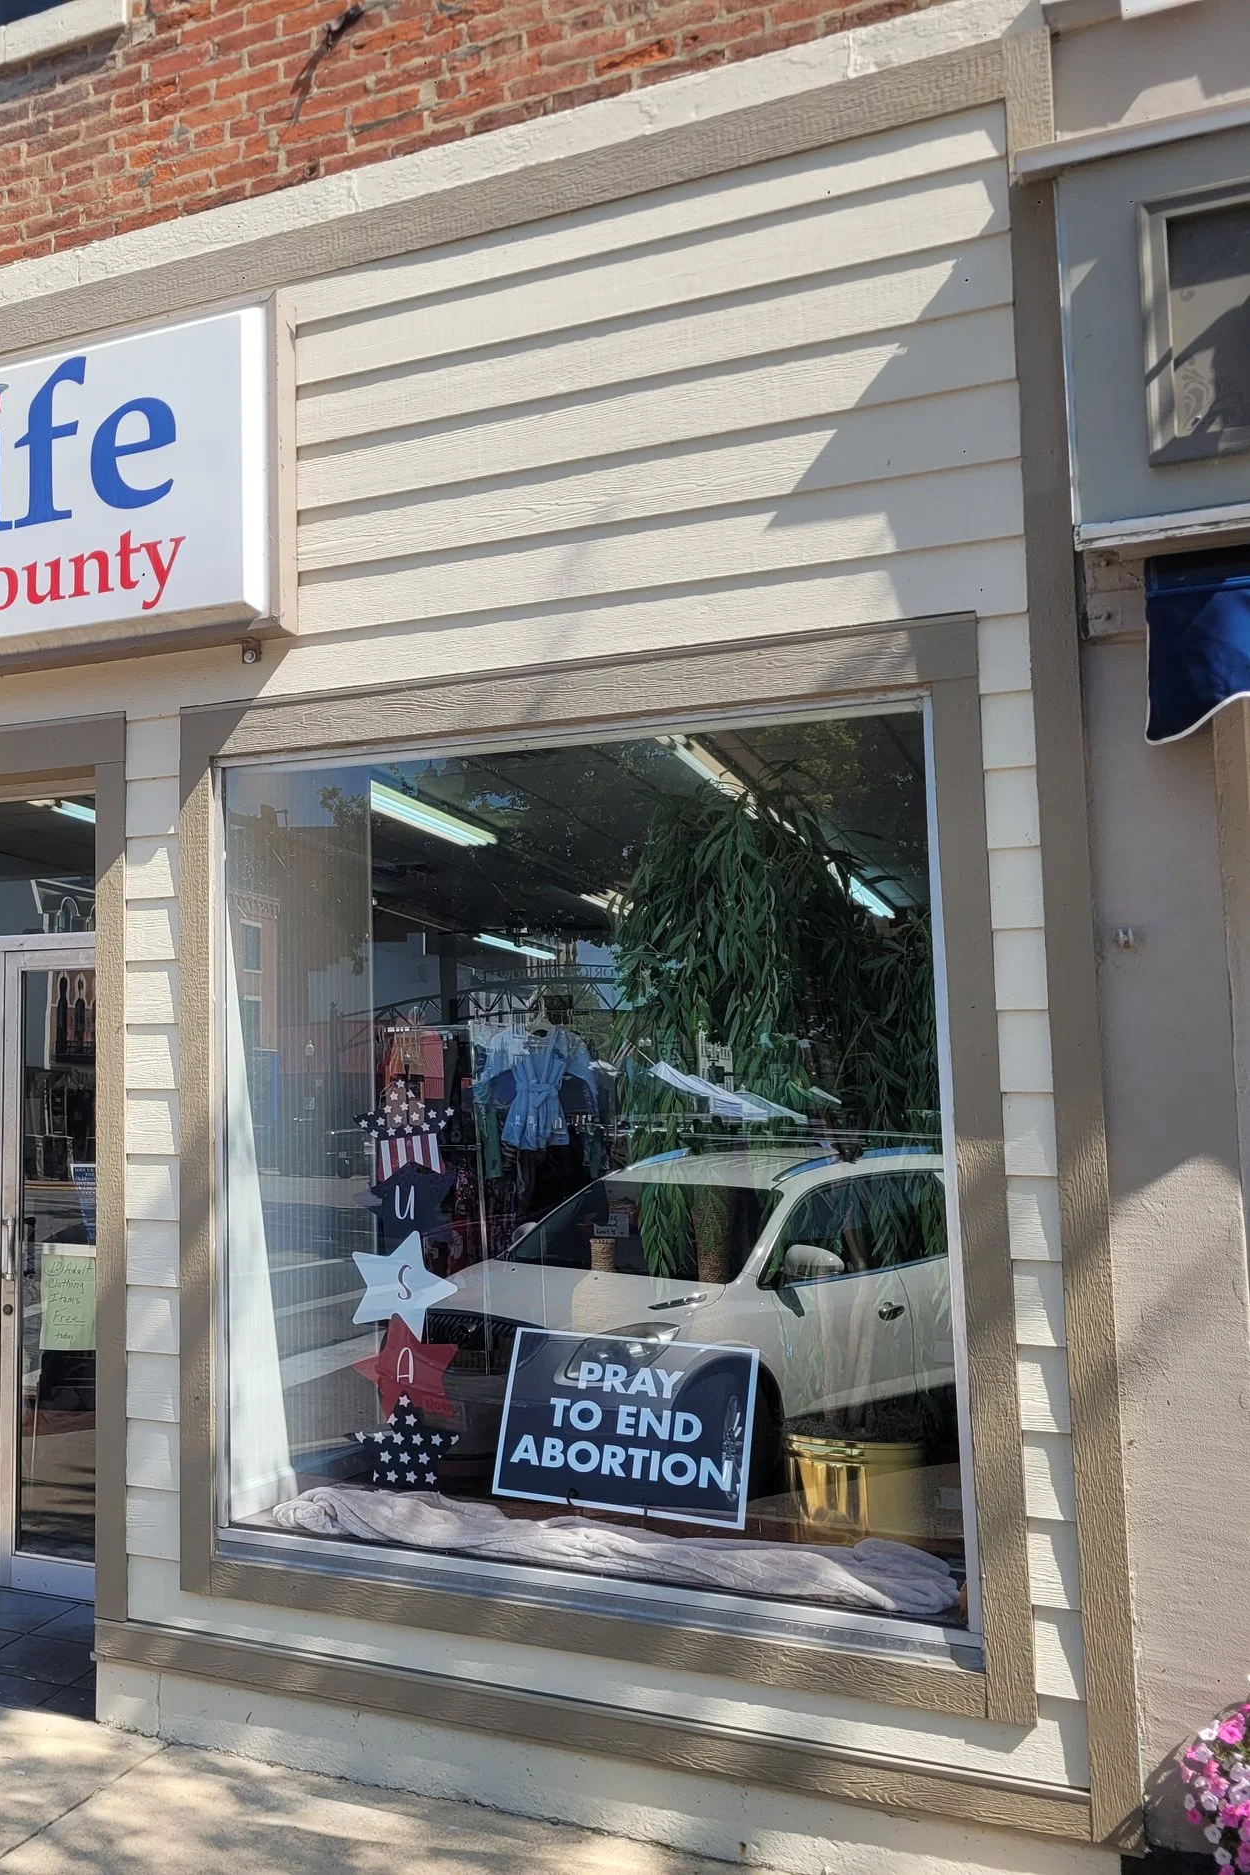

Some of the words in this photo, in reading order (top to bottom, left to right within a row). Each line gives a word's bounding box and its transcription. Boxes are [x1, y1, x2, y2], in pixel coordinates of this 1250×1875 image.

[52, 1307, 85, 1324] Free
[55, 1331, 74, 1344] today
[577, 1361, 685, 1399] PRAY
[550, 1397, 602, 1431] TO
[616, 1405, 703, 1443] END
[509, 1434, 733, 1491] ABORTION
